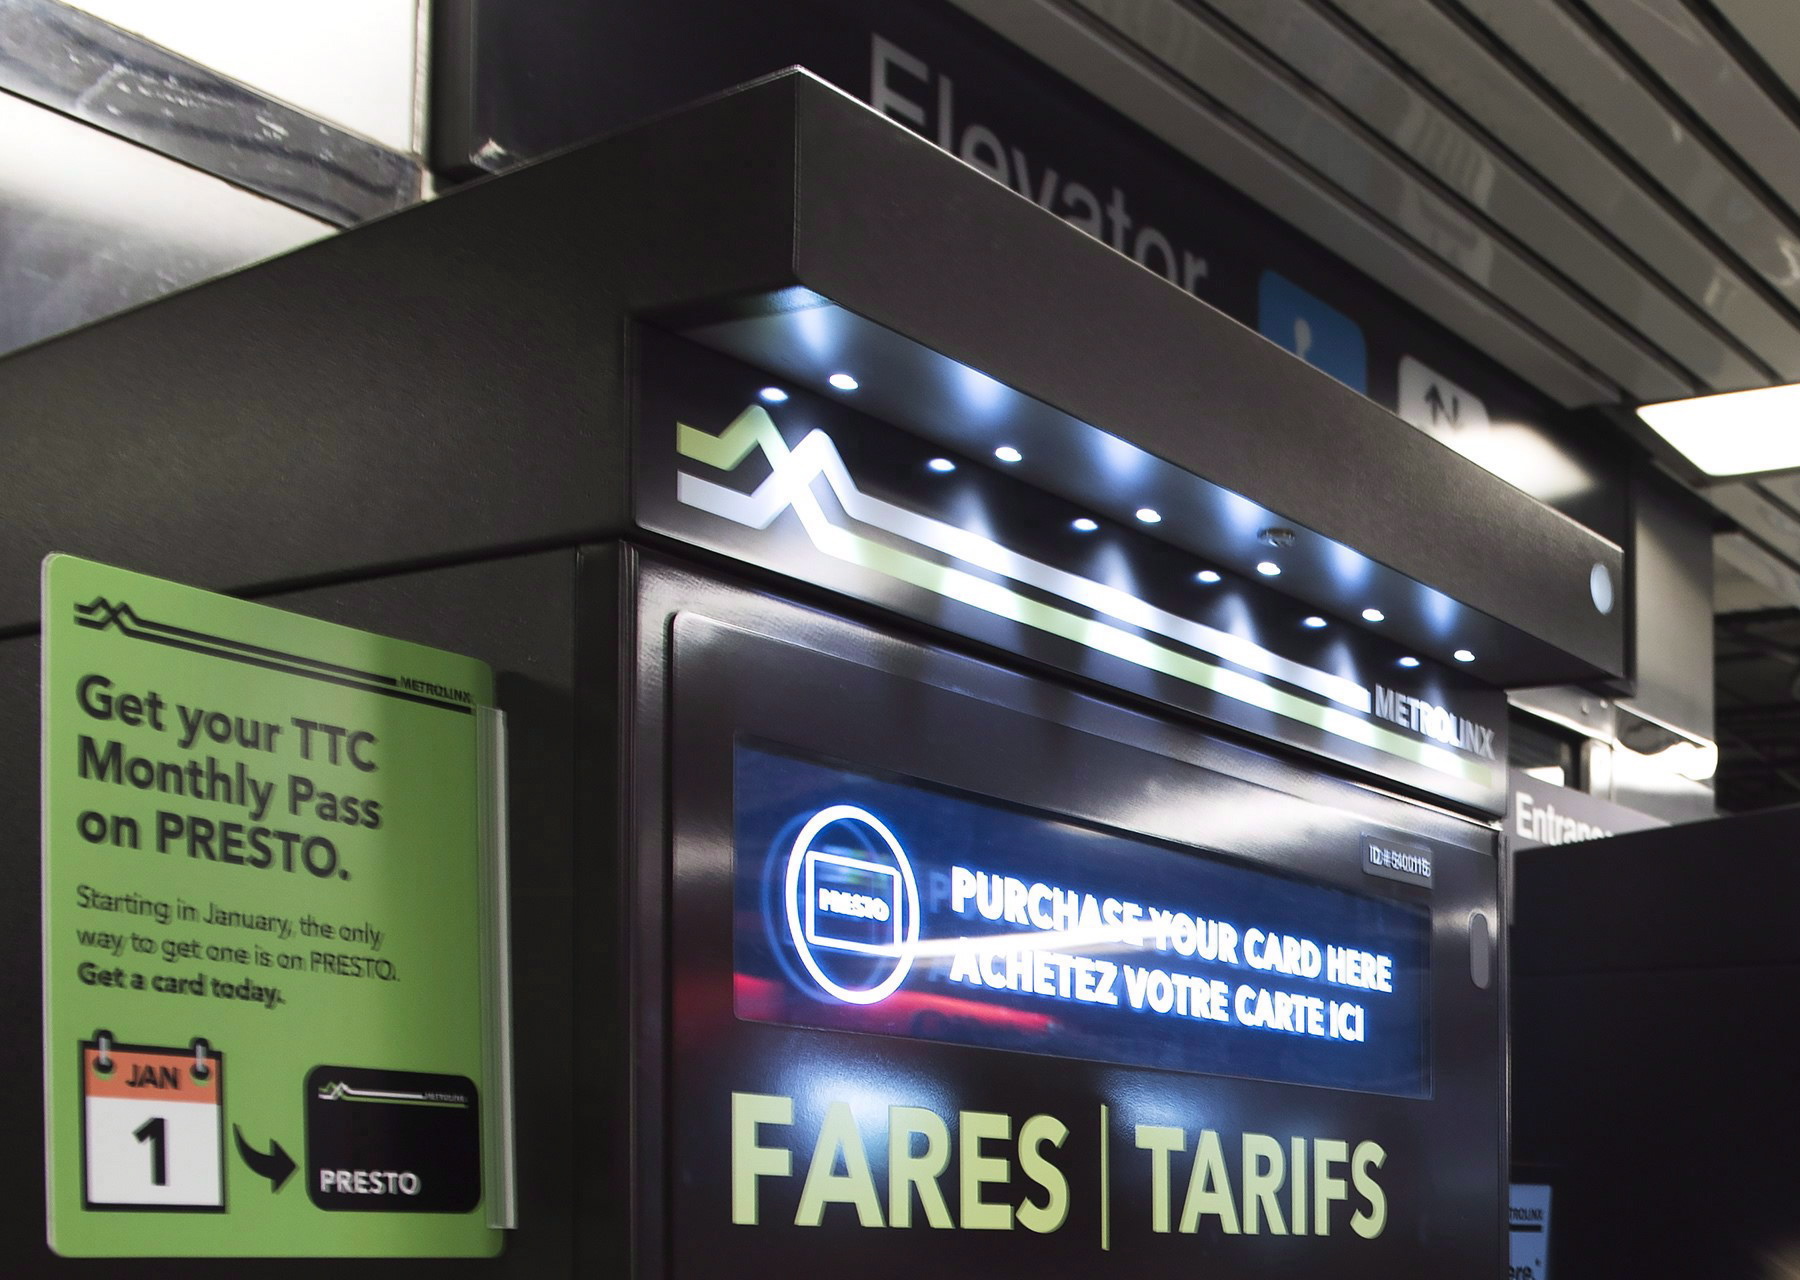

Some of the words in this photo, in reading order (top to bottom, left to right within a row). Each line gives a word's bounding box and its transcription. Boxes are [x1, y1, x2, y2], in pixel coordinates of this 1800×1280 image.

[76, 674, 167, 731] Get
[176, 703, 284, 752] your
[290, 717, 379, 772] TTC
[400, 676, 471, 704] METROLINX
[1374, 683, 1497, 760] METROLINX
[77, 733, 277, 821] Monthly
[288, 774, 383, 829] Pass
[76, 810, 142, 849] on
[156, 809, 350, 881] PRESTO.
[1515, 791, 1615, 846] Entran
[76, 883, 172, 924] Starting
[176, 897, 198, 922] in
[203, 901, 293, 940] January,
[299, 913, 335, 940] the
[338, 922, 384, 951] only
[818, 887, 891, 922] PRESTO
[951, 864, 1143, 946] PURCHASE
[1149, 906, 1238, 964] YOUR
[1244, 927, 1322, 978] CARD
[1327, 944, 1393, 993] HERE
[76, 927, 126, 957] way
[131, 932, 157, 955] to
[160, 938, 203, 963] get
[205, 946, 250, 966] one
[254, 944, 273, 967] is
[276, 951, 304, 972] on
[310, 950, 401, 982] PRESTO.
[77, 960, 128, 987] Get
[129, 971, 147, 991] a
[150, 973, 207, 997] card
[210, 976, 286, 1010] today.
[950, 937, 1118, 1005] ACHETEZ
[1123, 964, 1229, 1022] VOTRE
[1235, 984, 1324, 1037] CARTE
[1330, 1000, 1364, 1042] ICI
[125, 1064, 181, 1090] JAN
[132, 1117, 169, 1187] 1
[319, 1168, 422, 1196] PRESTO
[731, 1091, 1069, 1233] FARES
[1135, 1124, 1388, 1239] TARIFS
